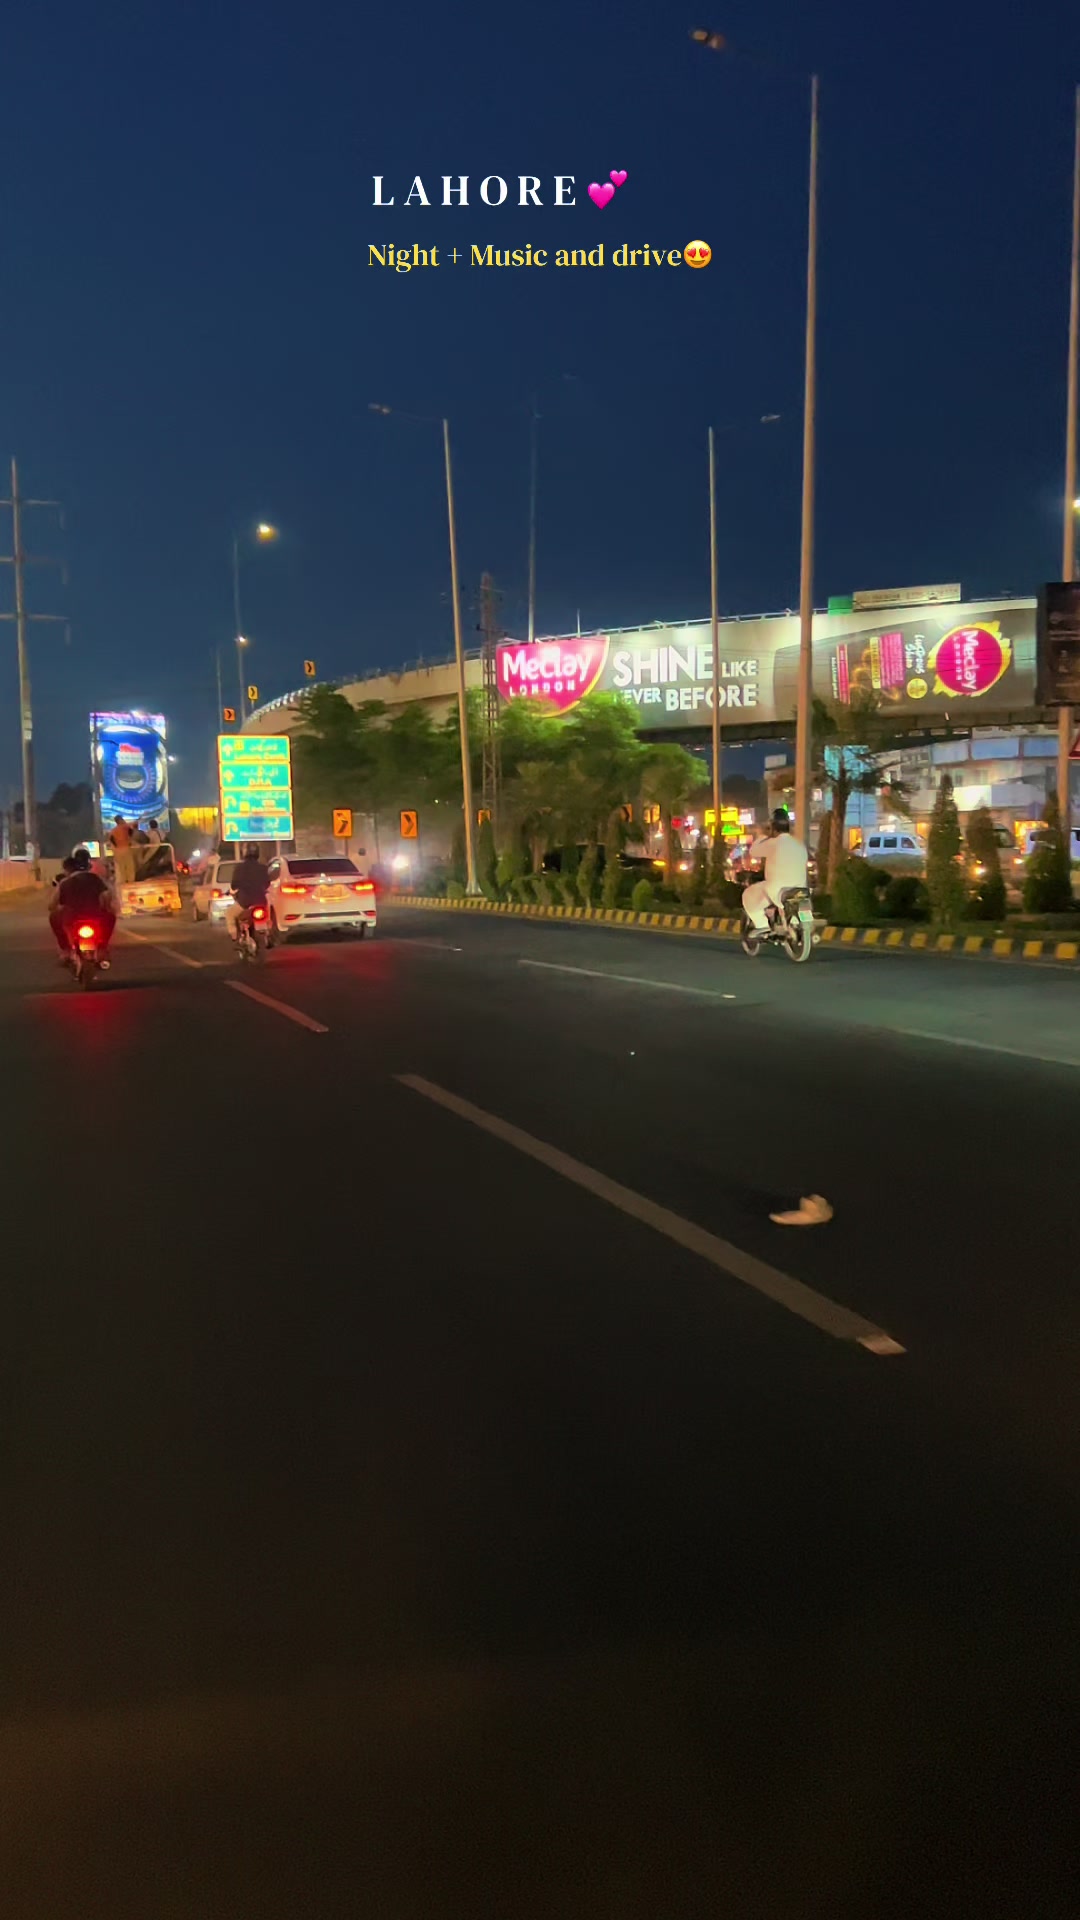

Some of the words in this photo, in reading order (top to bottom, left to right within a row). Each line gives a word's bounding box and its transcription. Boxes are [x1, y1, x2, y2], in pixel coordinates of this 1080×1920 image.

[502, 647, 594, 683] Meclay
[612, 644, 714, 687] SHINE
[721, 660, 758, 678] LIKE
[962, 630, 979, 690] Meclay
[509, 680, 577, 697] LONDON
[665, 684, 757, 711] BEFORE
